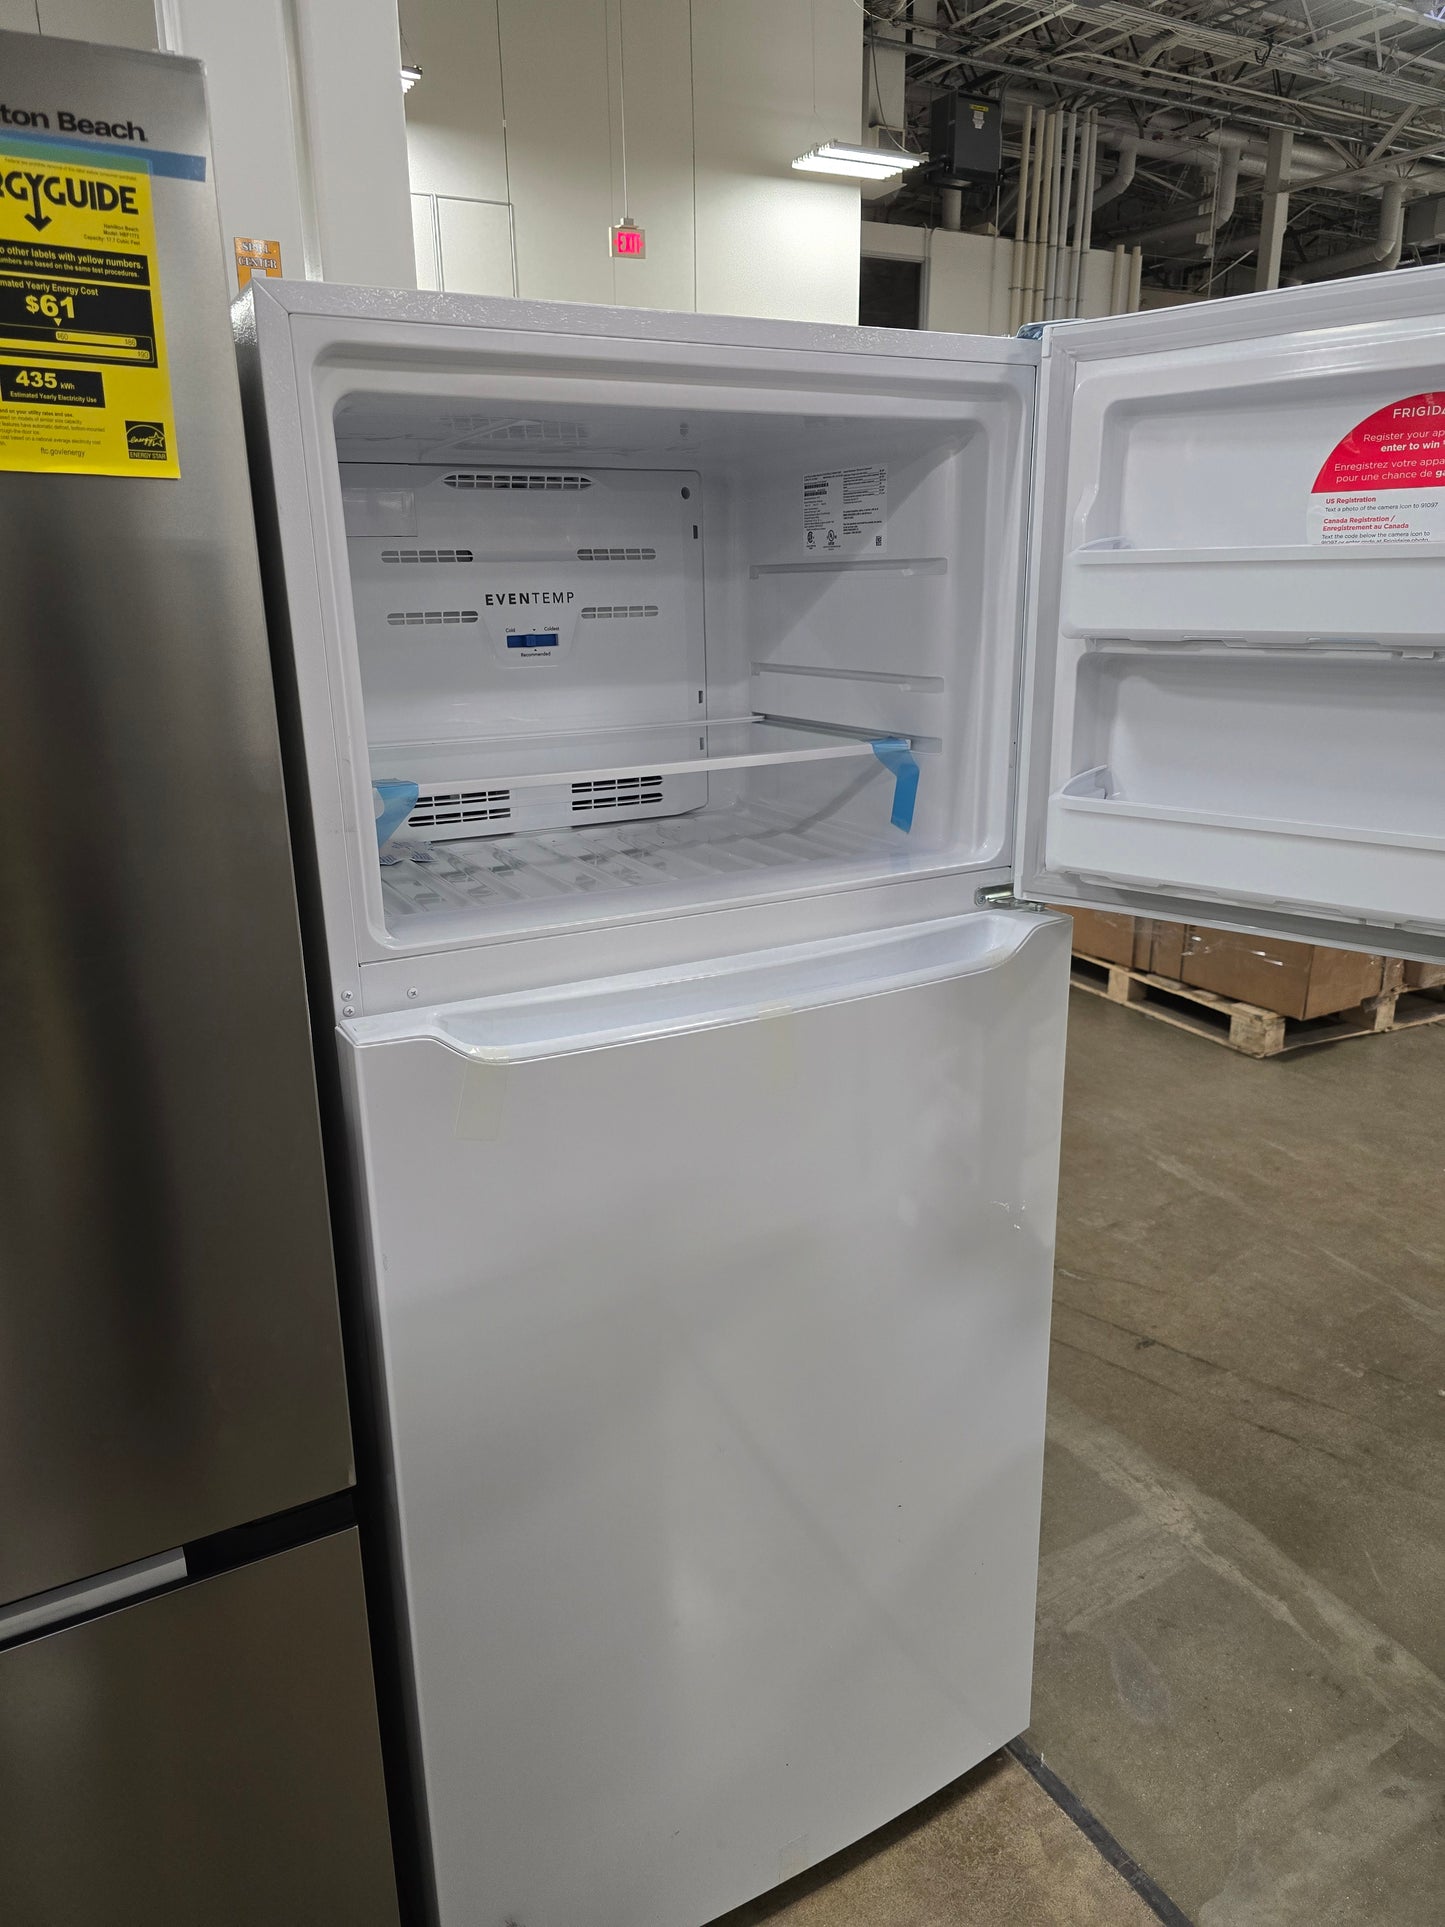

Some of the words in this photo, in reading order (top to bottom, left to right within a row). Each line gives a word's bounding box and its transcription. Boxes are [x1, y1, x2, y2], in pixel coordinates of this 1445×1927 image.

[57, 110, 146, 142] Beach
[617, 231, 641, 254] EXIT
[7, 246, 30, 257] other
[31, 248, 57, 260] labels
[58, 251, 76, 262] with
[78, 254, 104, 265] yellow
[105, 258, 144, 270] numbers.
[238, 256, 278, 269] CENTER
[34, 260, 54, 269] based
[63, 263, 74, 271] the
[91, 266, 104, 274] test
[25, 281, 50, 293] Yearly
[51, 283, 79, 296] Energy
[80, 286, 99, 296] Cost
[25, 294, 75, 319] $61
[15, 370, 58, 389] 435
[60, 382, 76, 390] kWh
[10, 390, 39, 399] Estimated
[39, 392, 57, 401] Yearly
[58, 394, 85, 403] Electricity
[1363, 432, 1405, 443] Register
[1407, 430, 1430, 440] your
[1381, 444, 1407, 453] enter
[1409, 442, 1421, 451] to
[1422, 440, 1440, 449] win
[130, 451, 151, 459] ENERGY
[151, 452, 166, 460] STAR
[1334, 460, 1389, 473] Enregistrez
[1391, 459, 1418, 468] votre
[1336, 474, 1359, 484] pour
[1361, 474, 1380, 482] une
[1381, 472, 1418, 480] chance
[1420, 470, 1433, 478] de
[1336, 496, 1377, 505] Registration
[1349, 516, 1390, 525] Registration
[1322, 524, 1373, 532] Enregistrement
[485, 591, 574, 606] EVENTEMP
